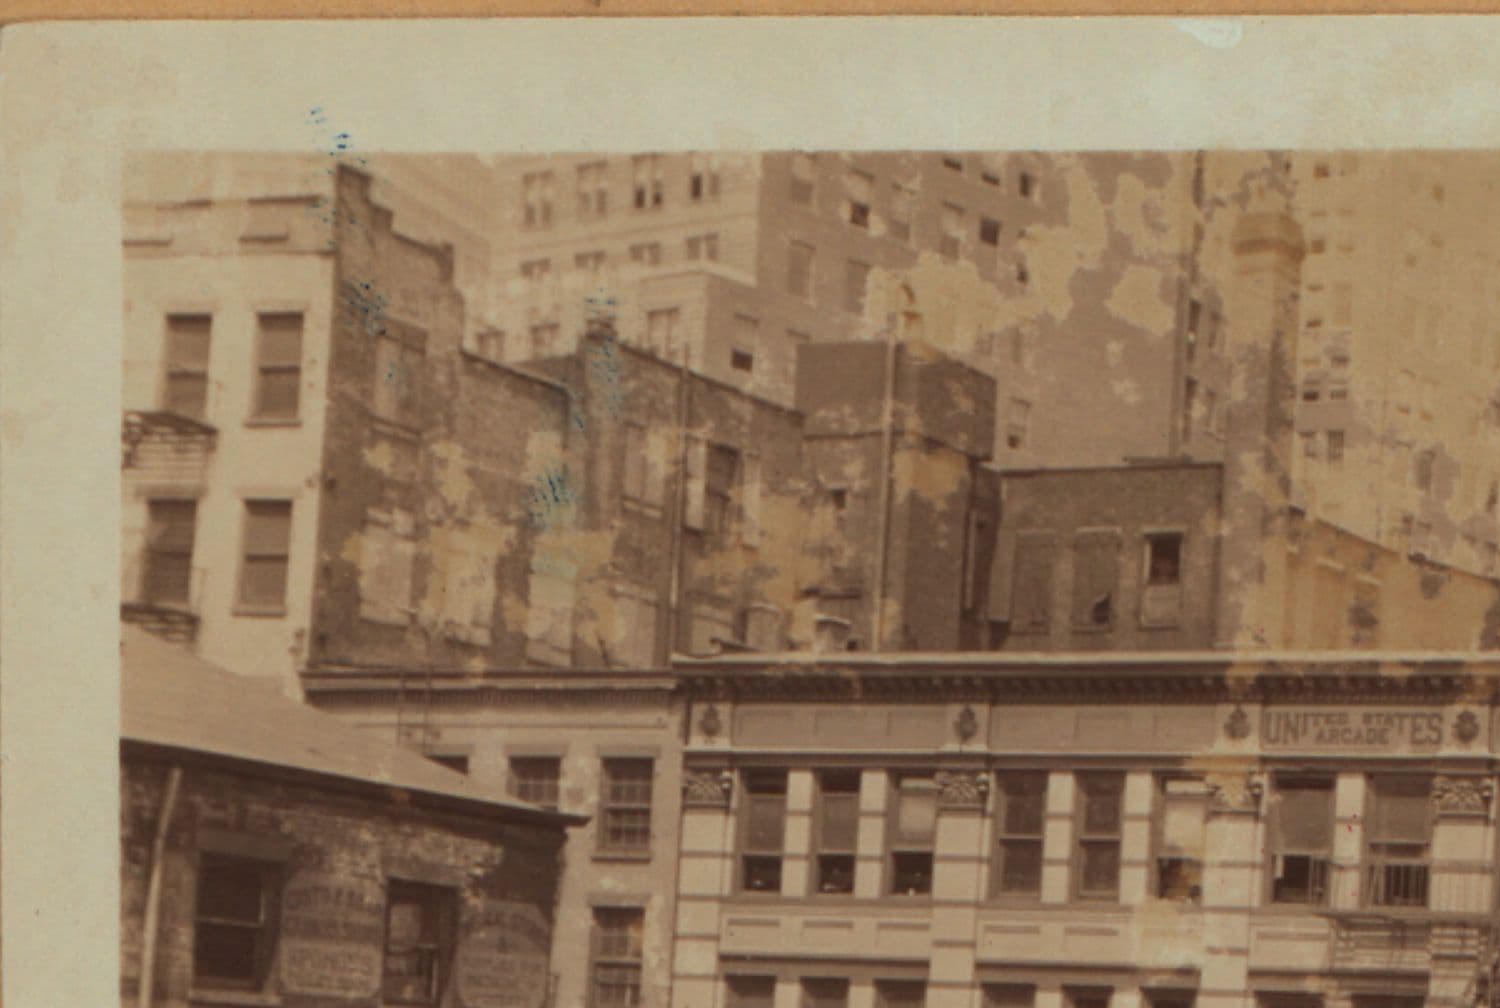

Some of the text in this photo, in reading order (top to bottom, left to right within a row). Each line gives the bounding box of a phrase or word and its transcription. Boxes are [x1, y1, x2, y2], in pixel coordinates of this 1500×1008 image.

[1264, 712, 1444, 745] UNITED STATES
[1314, 727, 1392, 745] ARCADE
